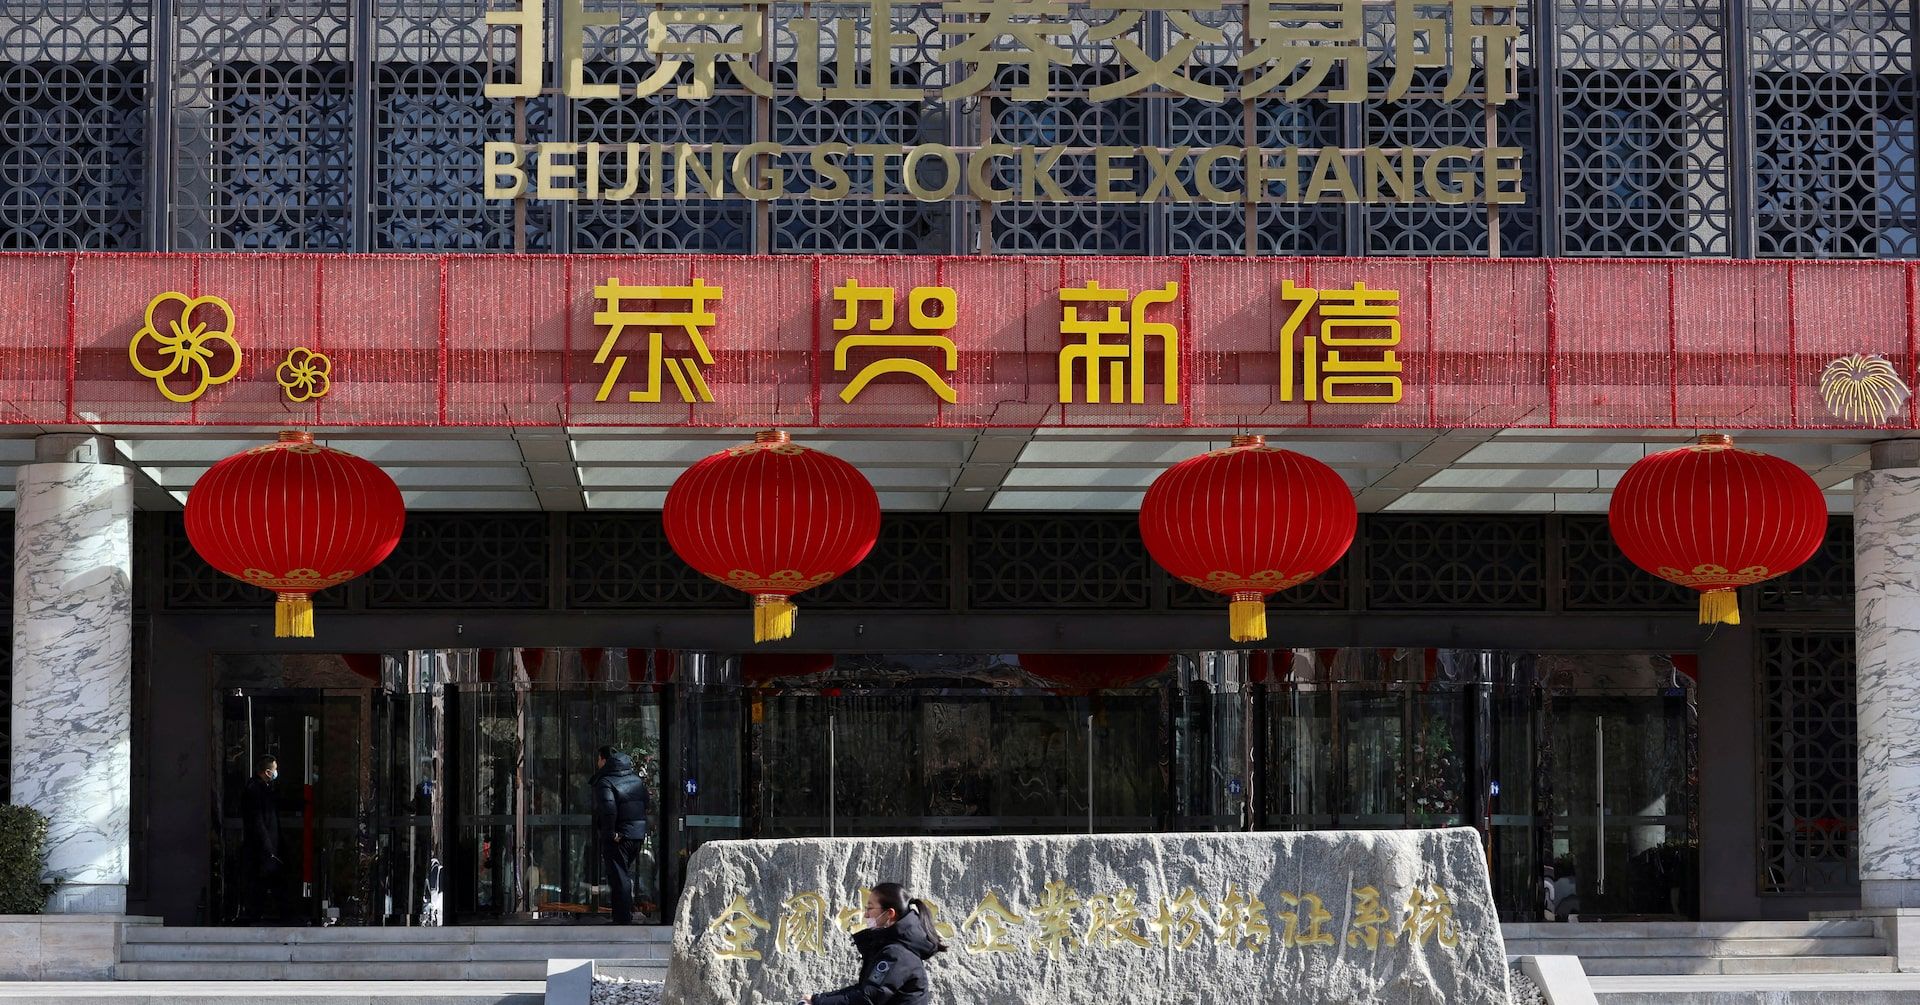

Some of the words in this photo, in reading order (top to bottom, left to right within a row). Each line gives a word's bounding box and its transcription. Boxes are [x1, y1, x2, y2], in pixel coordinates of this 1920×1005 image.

[485, 0, 1520, 104] 北京证券交易所
[484, 142, 785, 200] BEIJING
[810, 143, 1068, 203] STOCK
[1096, 145, 1526, 204] EXCHANGE
[593, 278, 1403, 404] 恭贺新禧
